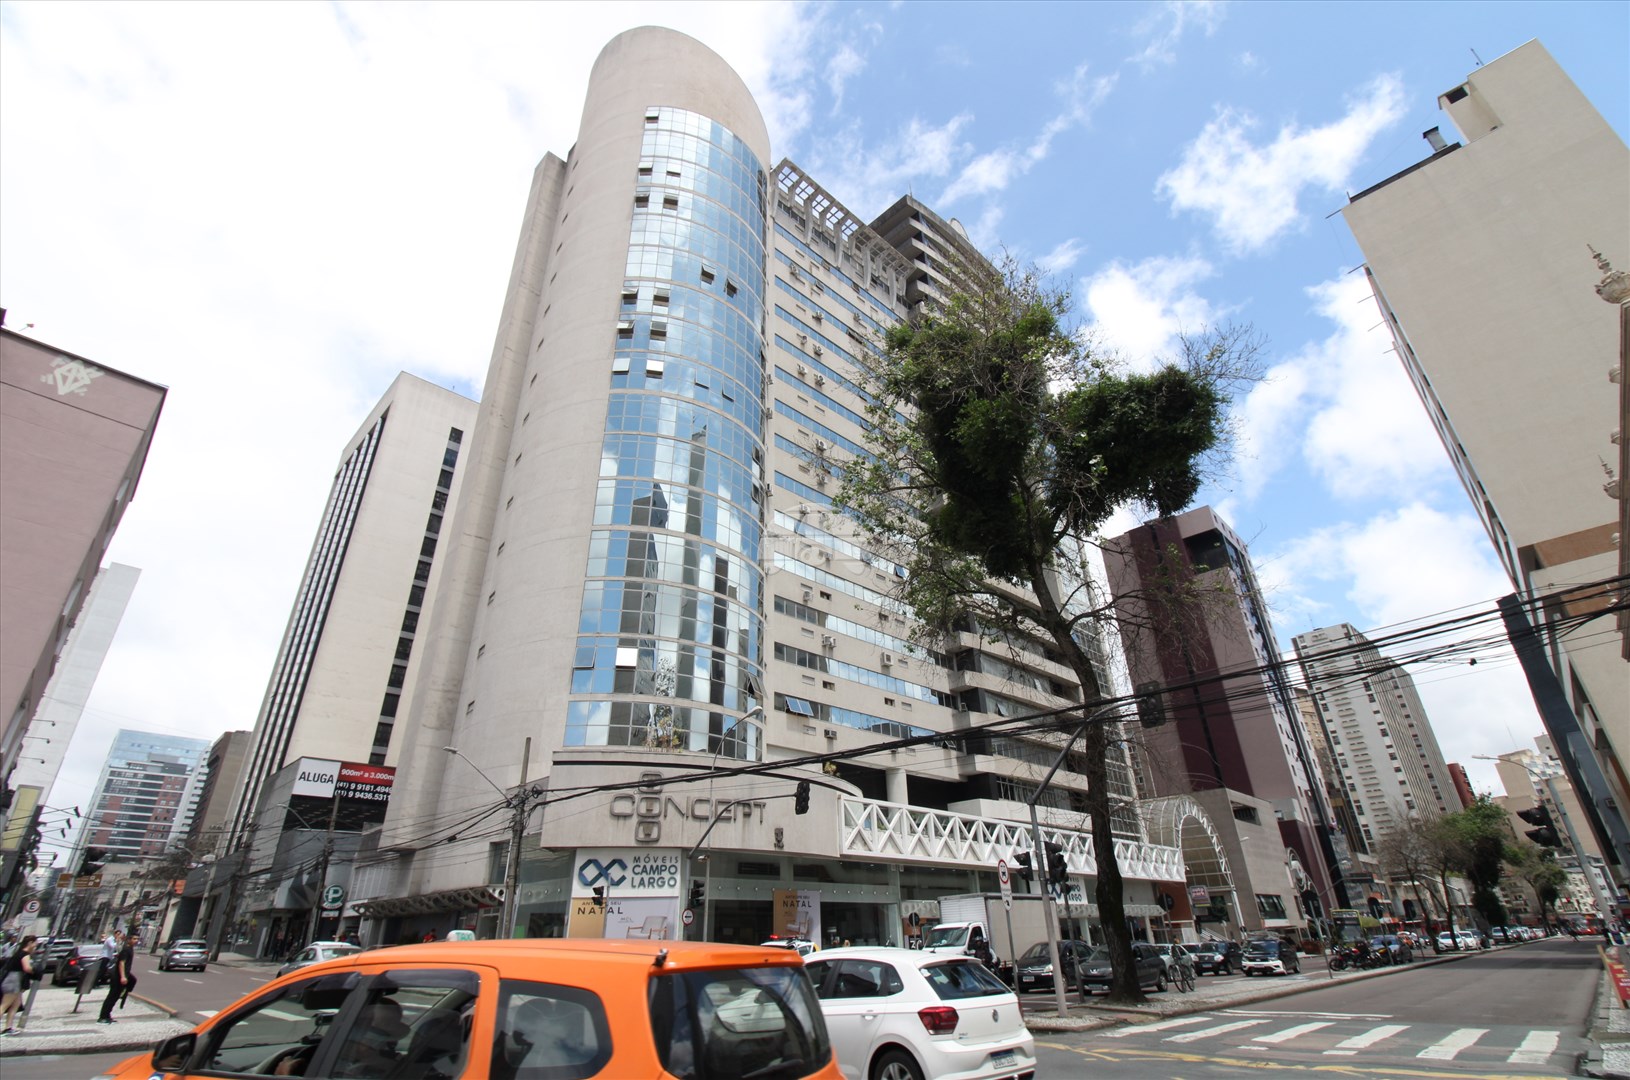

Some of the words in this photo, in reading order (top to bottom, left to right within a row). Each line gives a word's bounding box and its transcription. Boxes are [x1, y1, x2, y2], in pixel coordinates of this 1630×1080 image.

[298, 771, 334, 784] ALUGA
[341, 768, 363, 777] 900m²
[336, 781, 348, 789] (41)
[348, 790, 354, 798] 9
[609, 793, 767, 826] CONCEPT
[632, 853, 679, 864] MÓVEIS
[632, 864, 678, 876] CAMPO
[630, 876, 678, 889] LARGO
[328, 887, 343, 901] P
[29, 902, 37, 910] E
[782, 900, 813, 908] NATAL
[577, 906, 624, 915] NATAL
